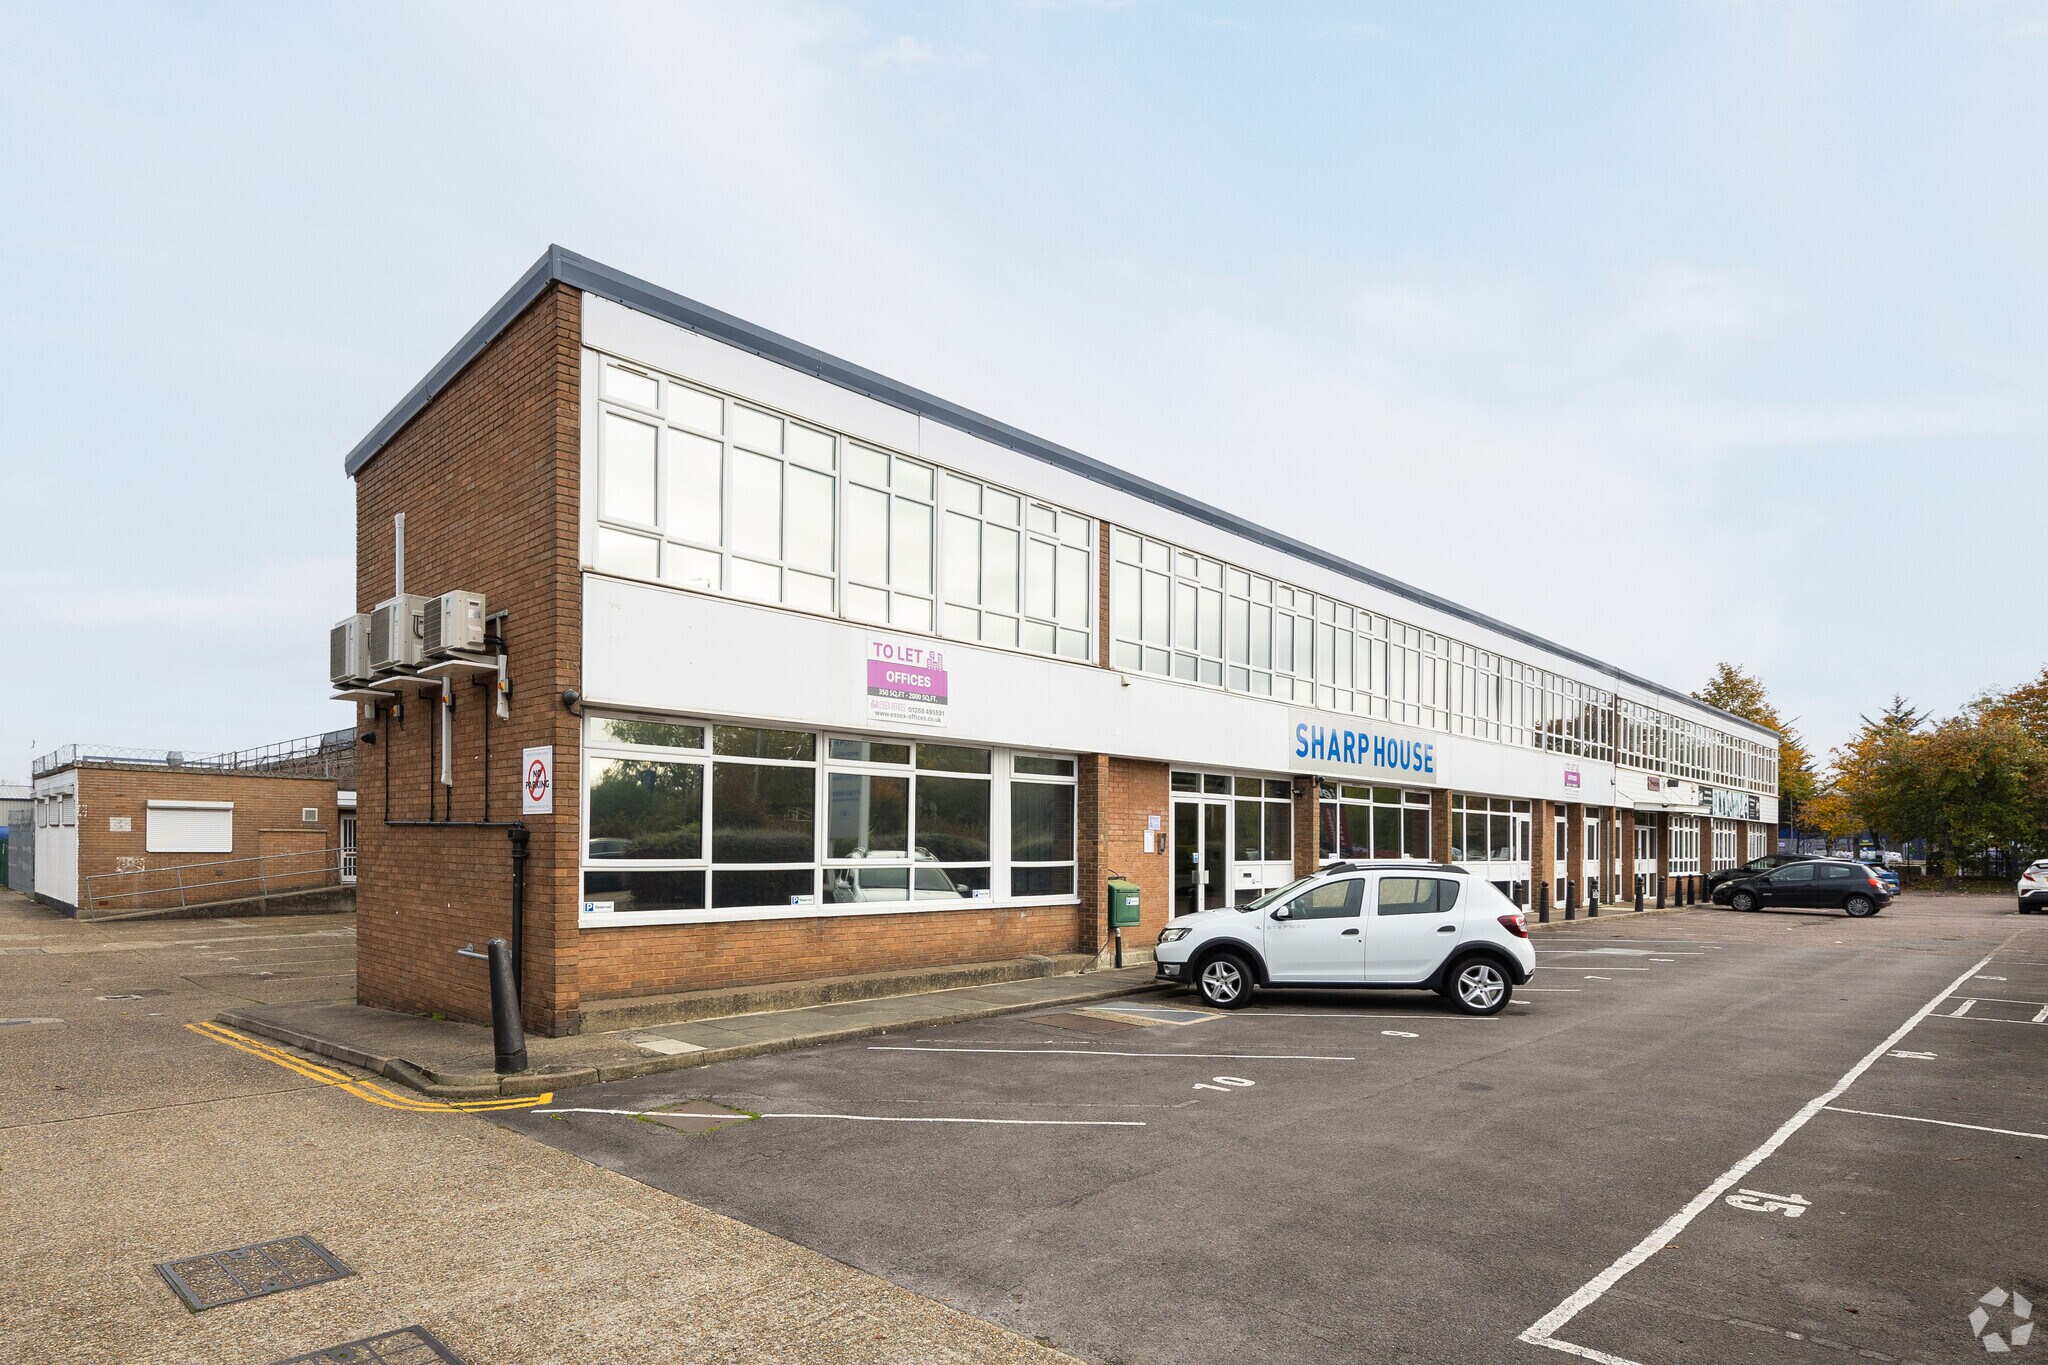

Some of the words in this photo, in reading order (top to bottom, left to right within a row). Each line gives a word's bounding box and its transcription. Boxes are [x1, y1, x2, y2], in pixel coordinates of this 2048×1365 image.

[873, 642, 893, 659] TO
[897, 646, 923, 664] LET
[886, 671, 931, 687] OFFICES
[878, 688, 889, 696] 350
[908, 692, 921, 700] 2000
[1295, 723, 1370, 764] SHARP
[1373, 735, 1434, 773] HOUSE
[532, 769, 542, 778] NO
[525, 780, 550, 790] PARKING
[1192, 1076, 1256, 1092] 10
[1725, 1188, 1813, 1218] 15
